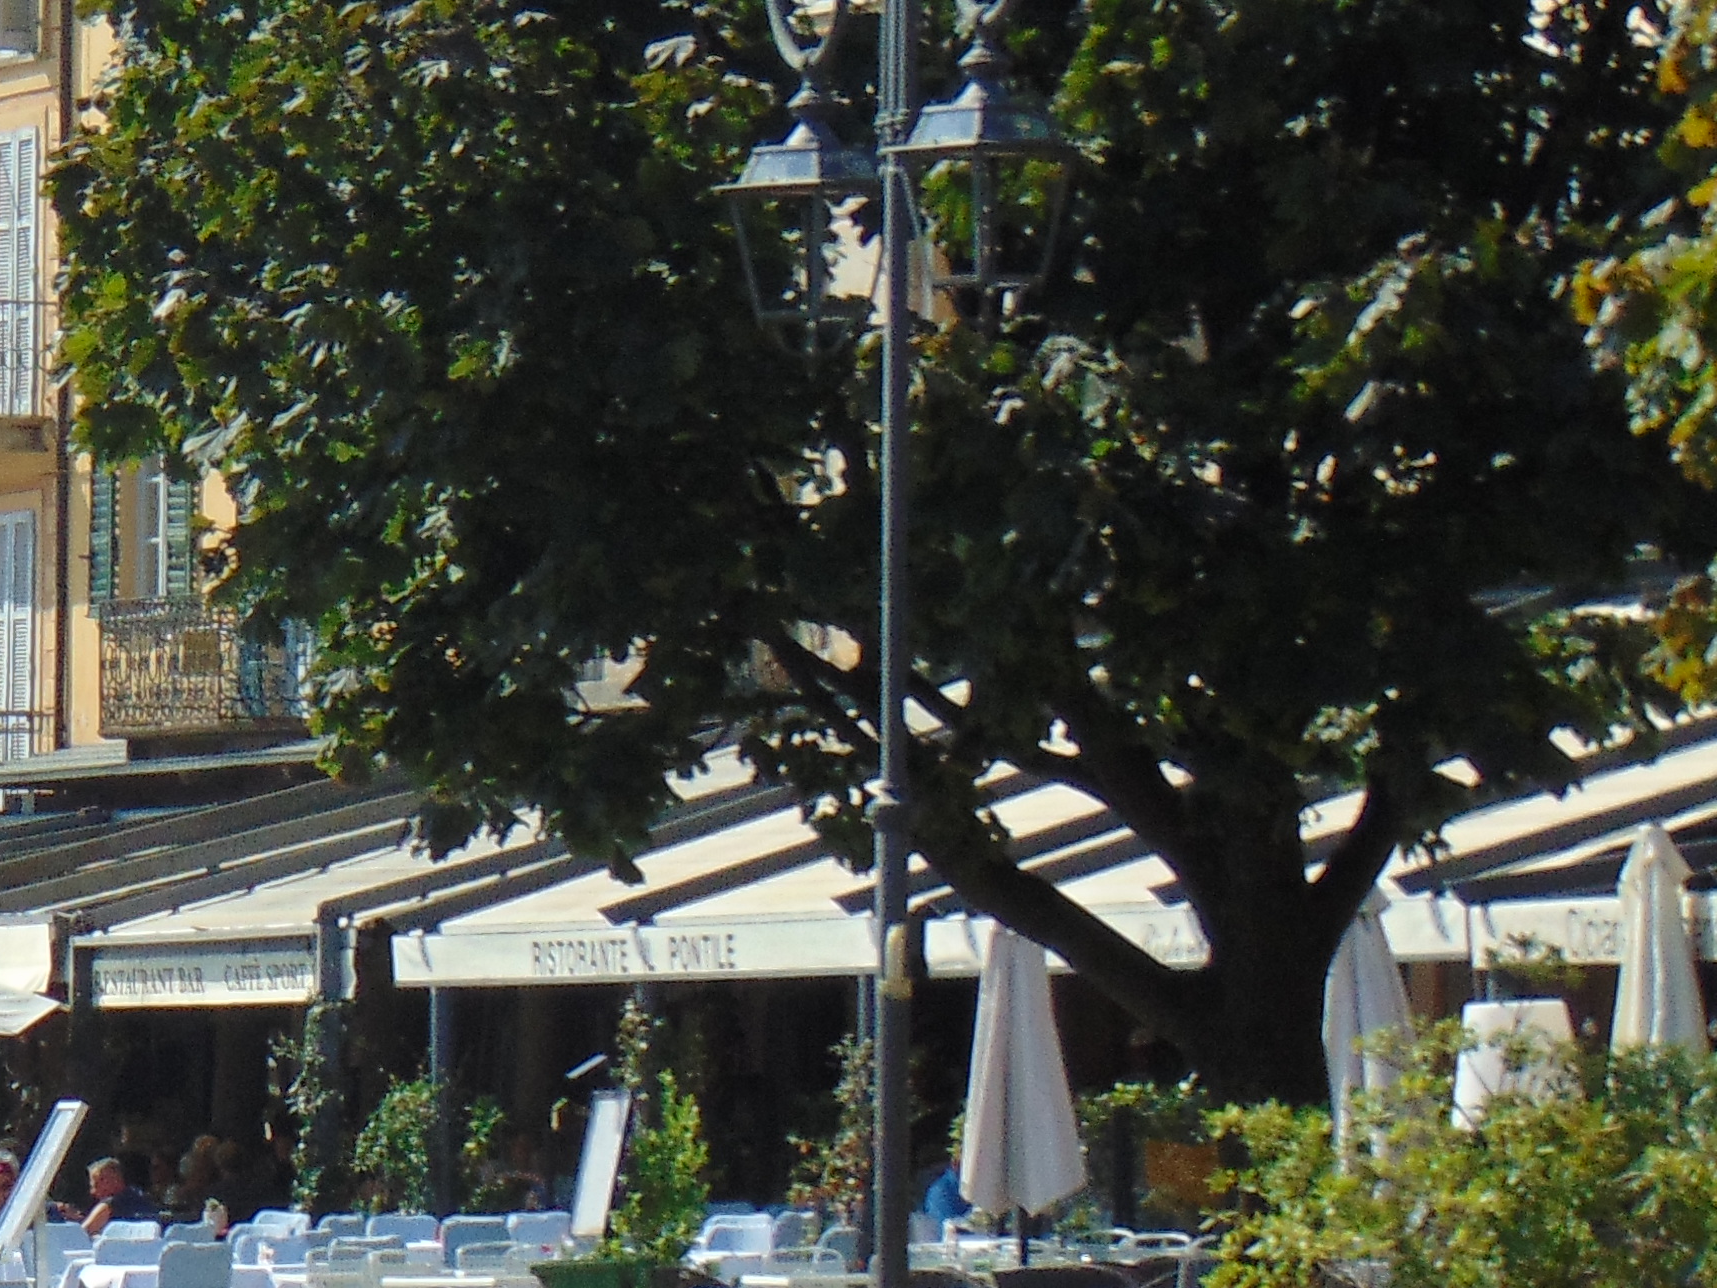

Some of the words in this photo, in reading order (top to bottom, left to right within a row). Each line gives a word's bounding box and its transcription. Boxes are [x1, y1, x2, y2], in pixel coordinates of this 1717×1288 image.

[532, 939, 629, 976] RISTORANTE
[668, 933, 736, 972] PONTILE
[94, 966, 175, 996] RESTAURANT
[177, 965, 206, 994] BAR
[266, 963, 308, 990] SPORT
